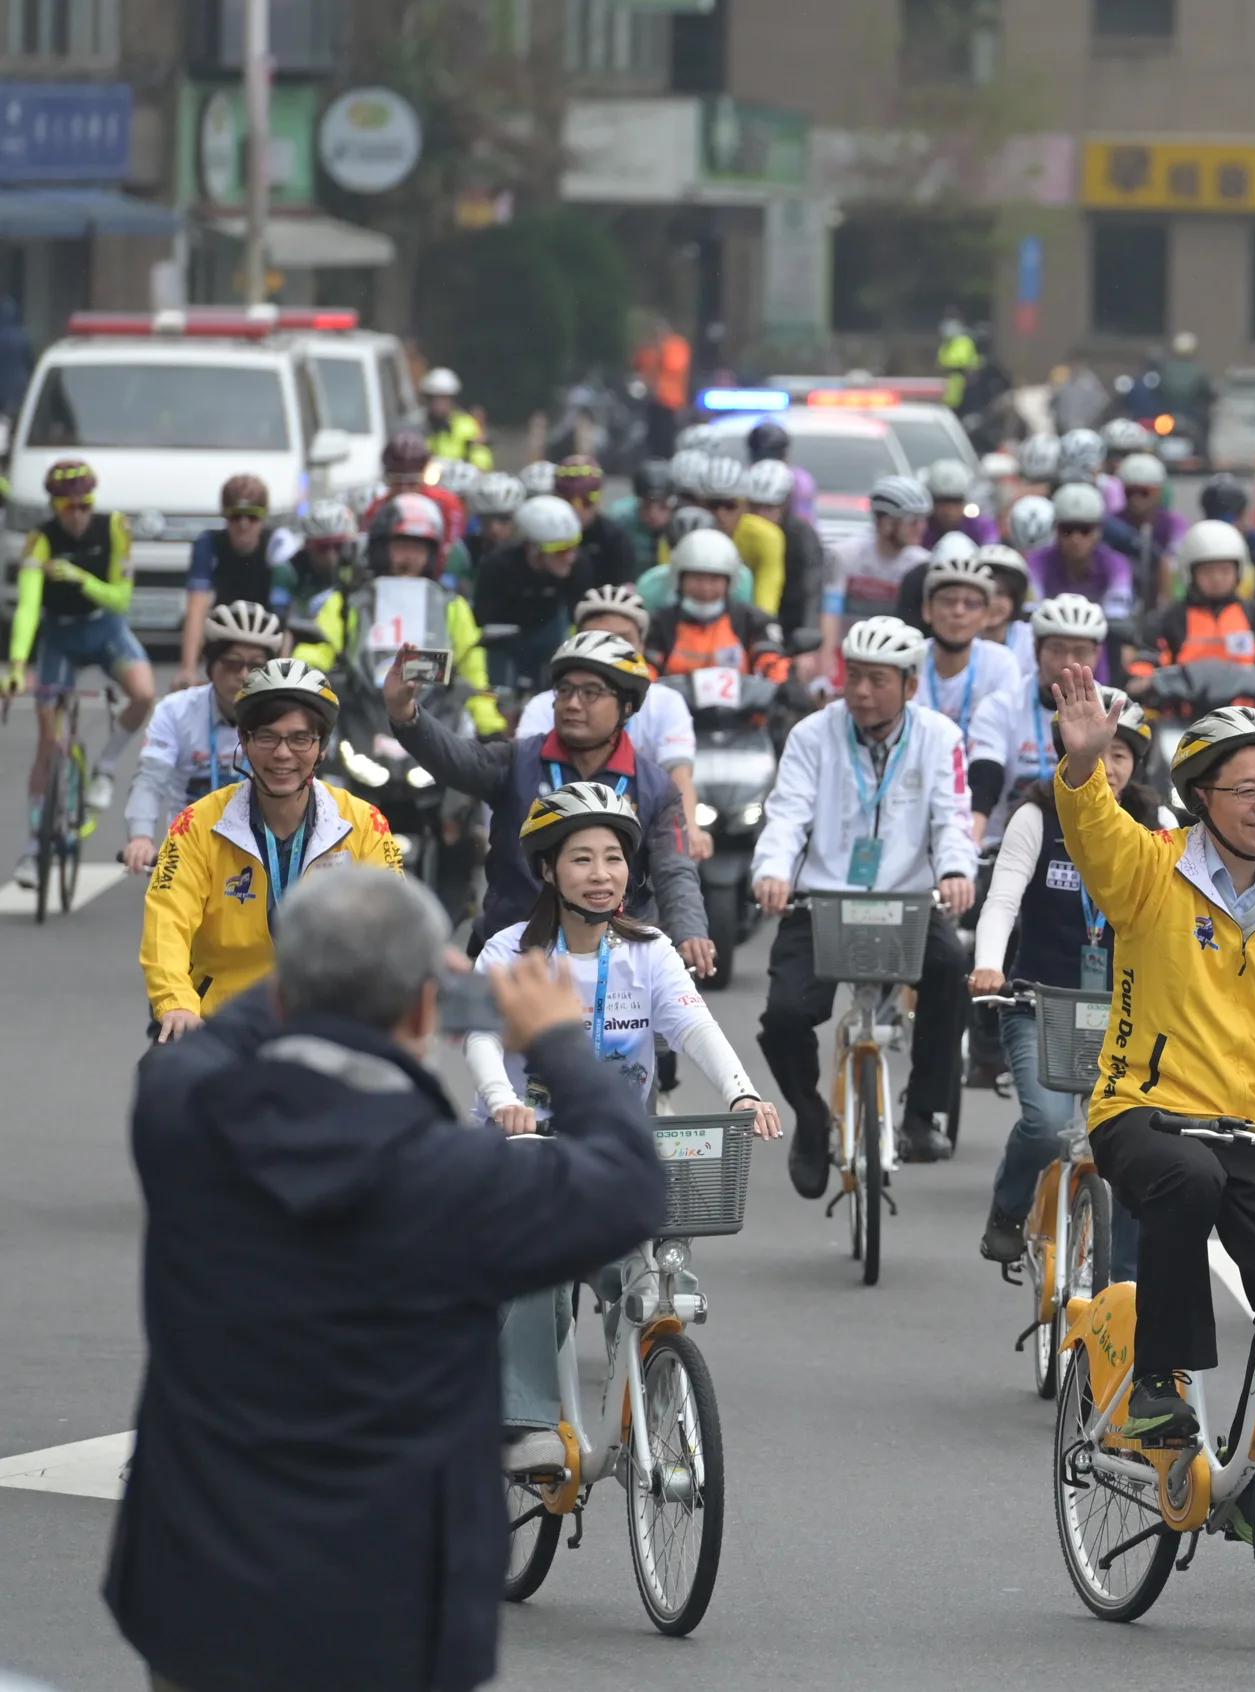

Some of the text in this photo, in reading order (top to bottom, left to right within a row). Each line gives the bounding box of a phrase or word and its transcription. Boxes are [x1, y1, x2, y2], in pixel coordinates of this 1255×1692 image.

[393, 616, 403, 645] 1
[719, 672, 735, 699] 2
[1121, 968, 1135, 1017] Tour
[604, 1017, 650, 1031] aiwan
[1116, 1018, 1133, 1049] De
[656, 1129, 706, 1138] 0301912
